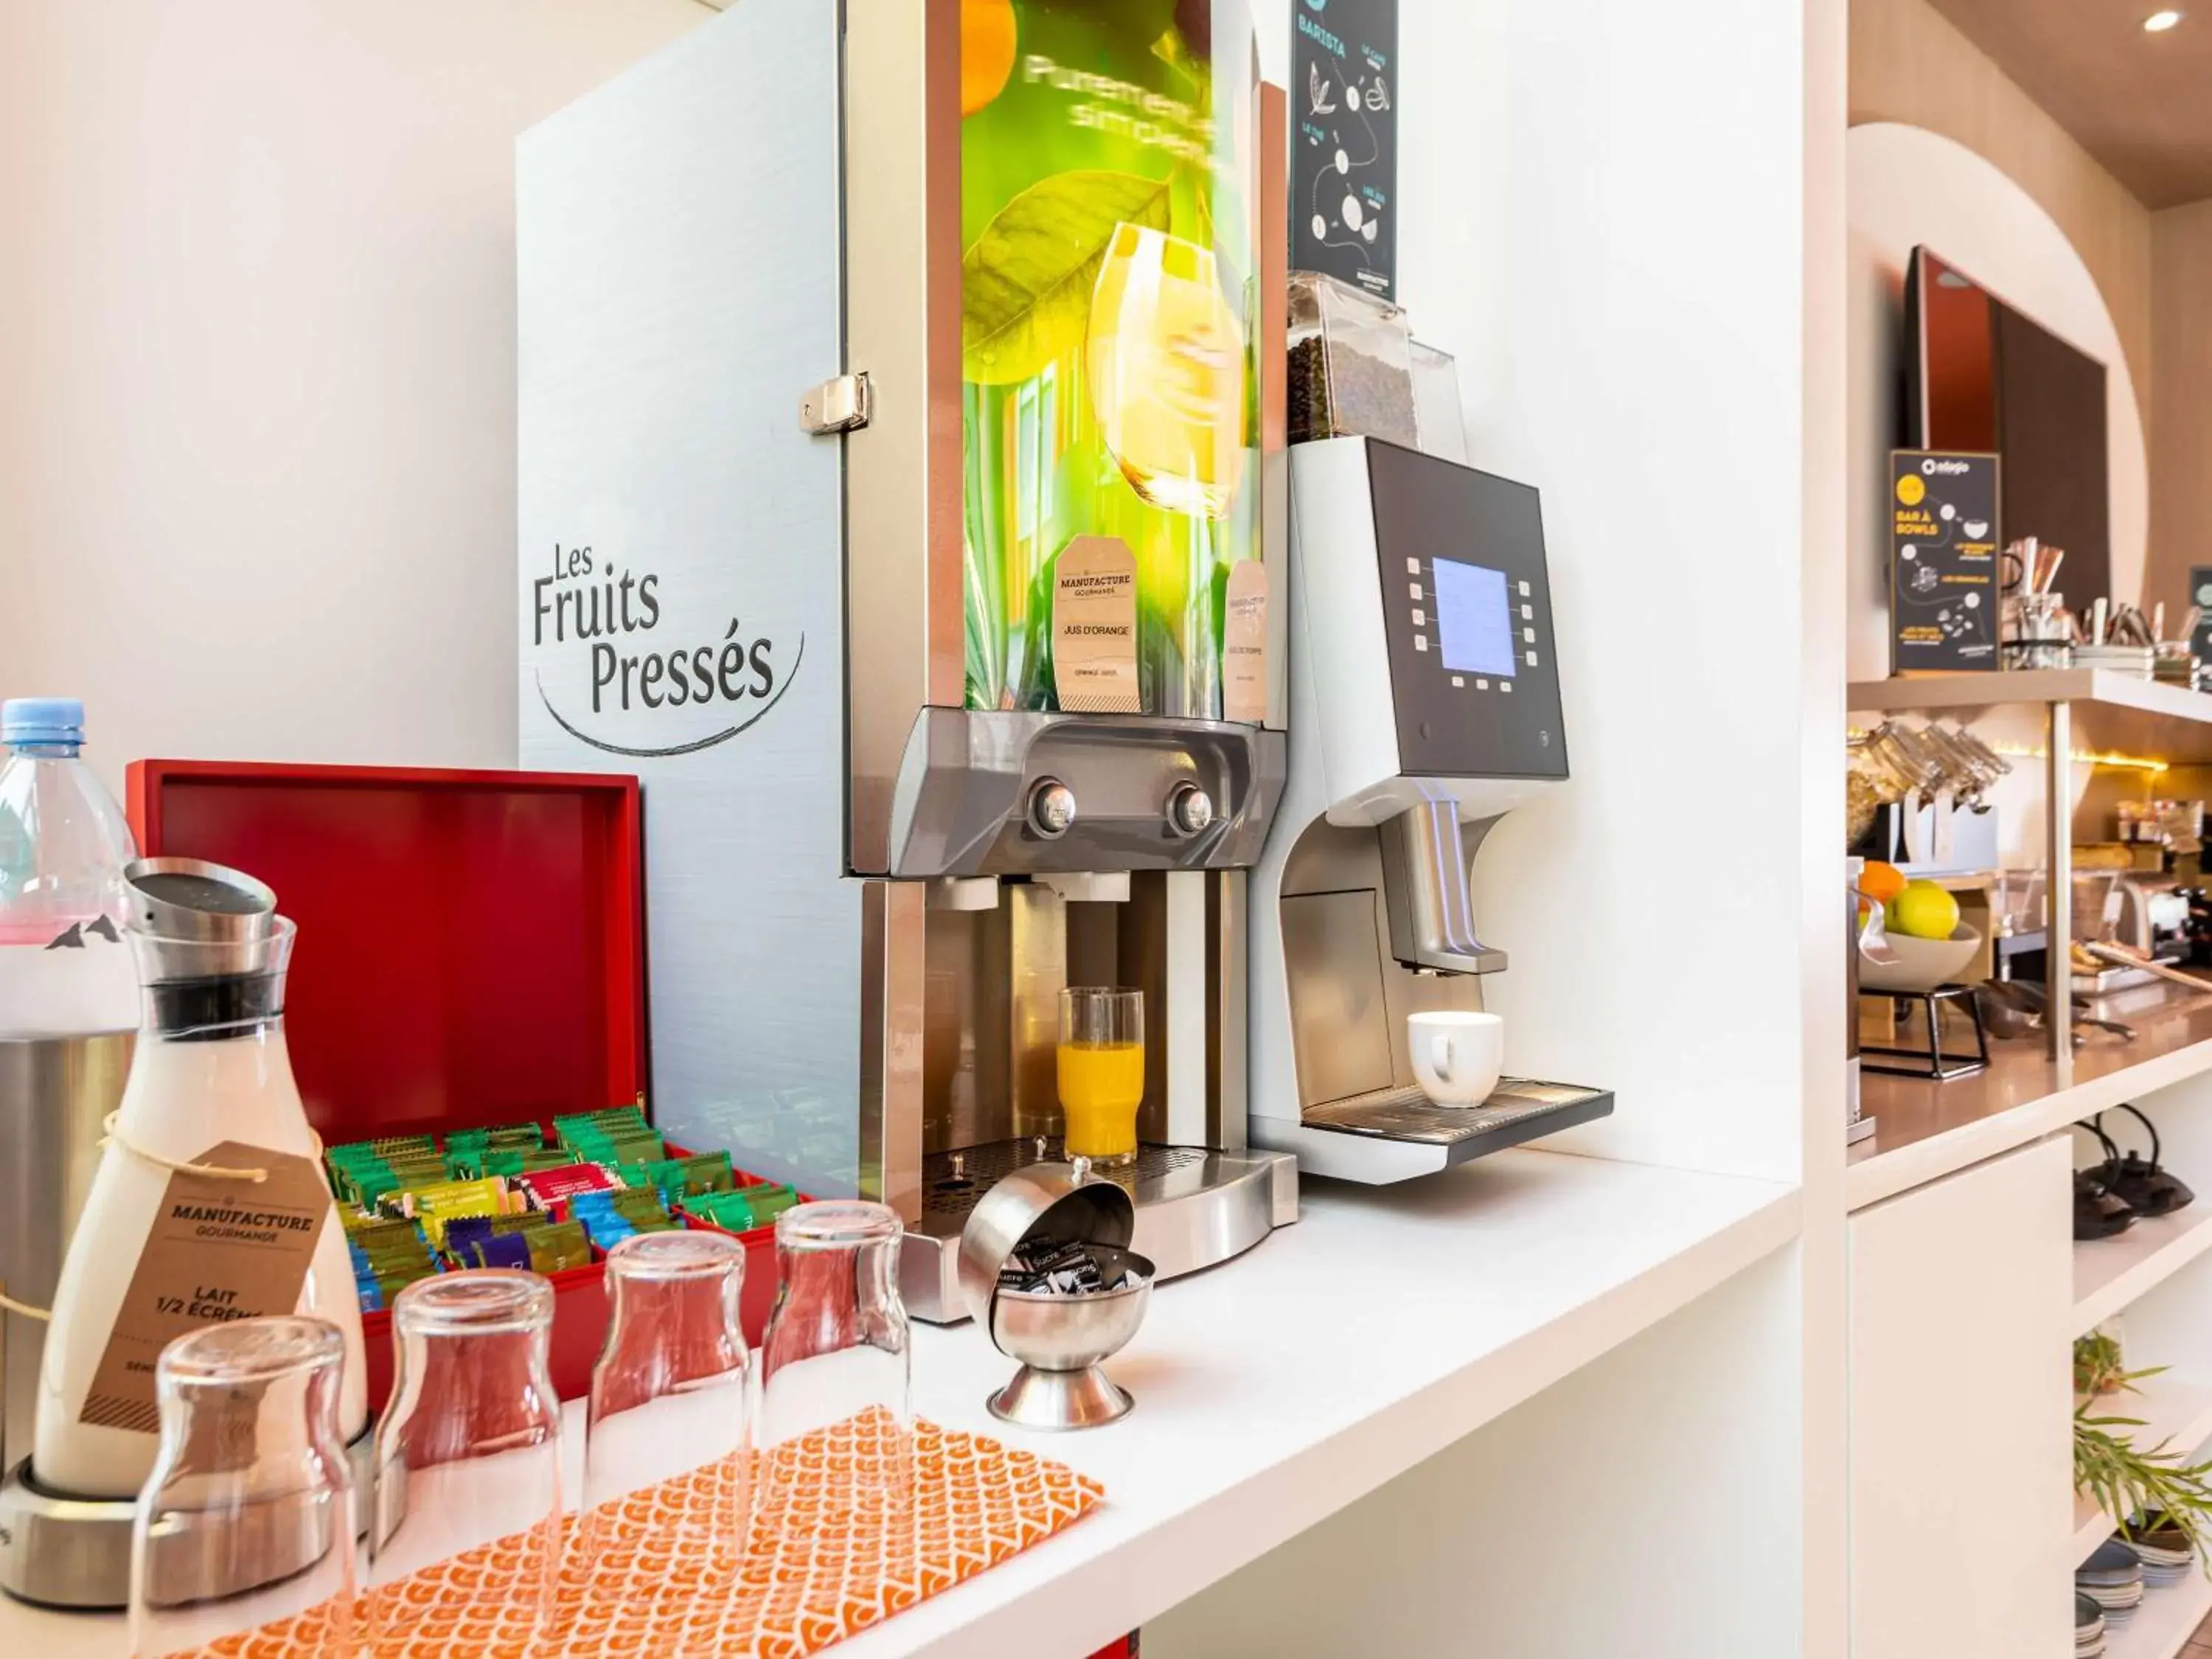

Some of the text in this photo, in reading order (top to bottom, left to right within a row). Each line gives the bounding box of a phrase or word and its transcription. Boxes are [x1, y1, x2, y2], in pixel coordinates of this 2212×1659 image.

[1298, 13, 1346, 59] BARISTA
[555, 543, 593, 580] Les
[1060, 574, 1131, 588] MANUFACTURE
[534, 562, 660, 646] Fruits
[1064, 625, 1130, 636] JUS D'ORANGE
[592, 617, 773, 714] Pressés
[171, 1204, 313, 1232] MANUFACTURE
[195, 1225, 278, 1242] GOURMANDE
[1033, 1252, 1060, 1267] Sucre
[195, 1286, 238, 1304] LAIT
[156, 1297, 263, 1321] 1/2 ÉCRÉM
